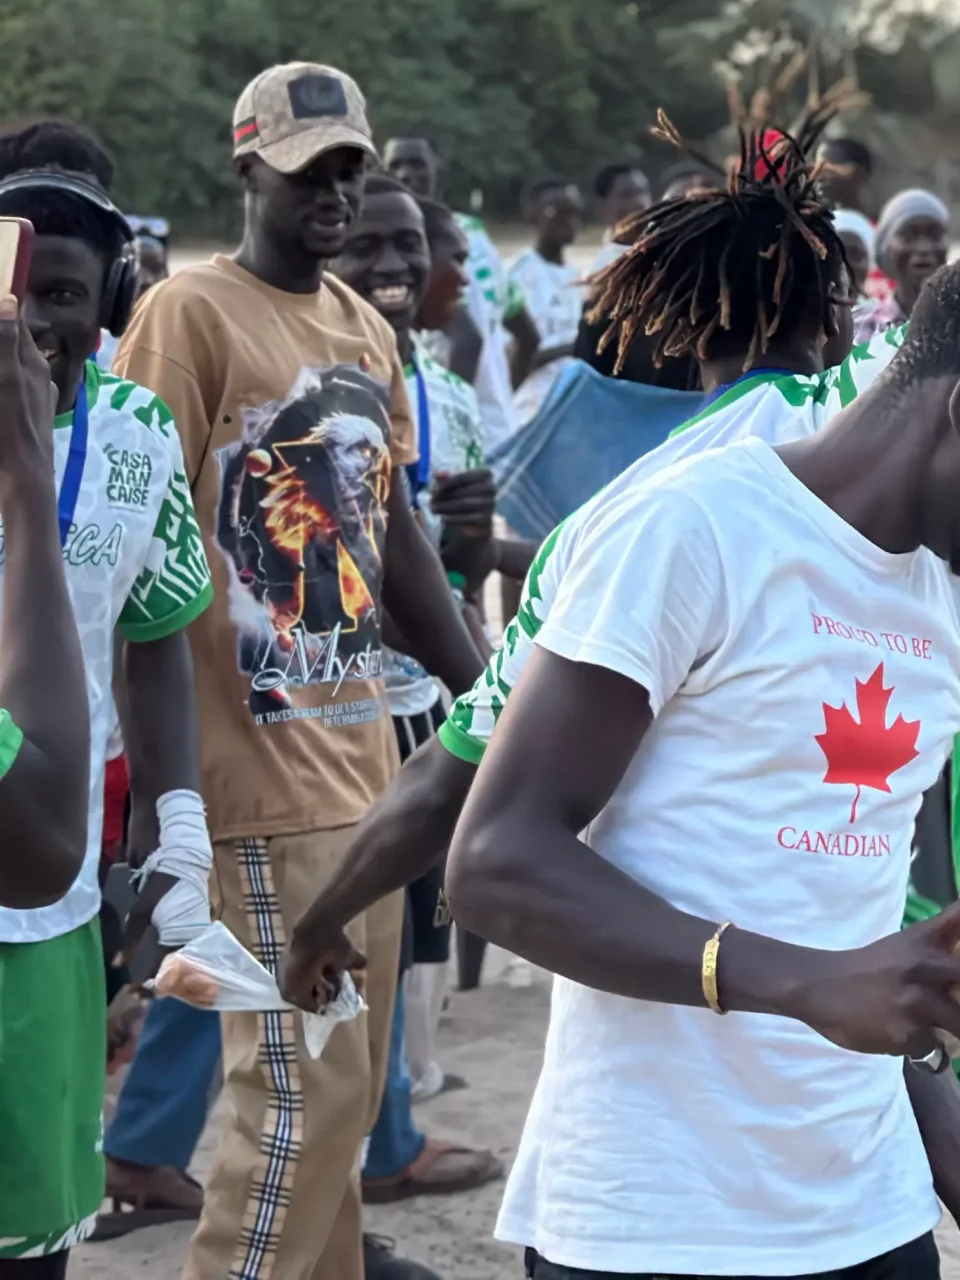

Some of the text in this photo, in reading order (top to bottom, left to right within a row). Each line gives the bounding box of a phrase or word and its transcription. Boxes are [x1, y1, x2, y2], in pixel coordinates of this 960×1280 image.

[107, 449, 152, 471] CASA
[108, 466, 152, 487] MAN
[812, 613, 932, 660] PROUD TO BE
[777, 826, 892, 857] CANADIAN
